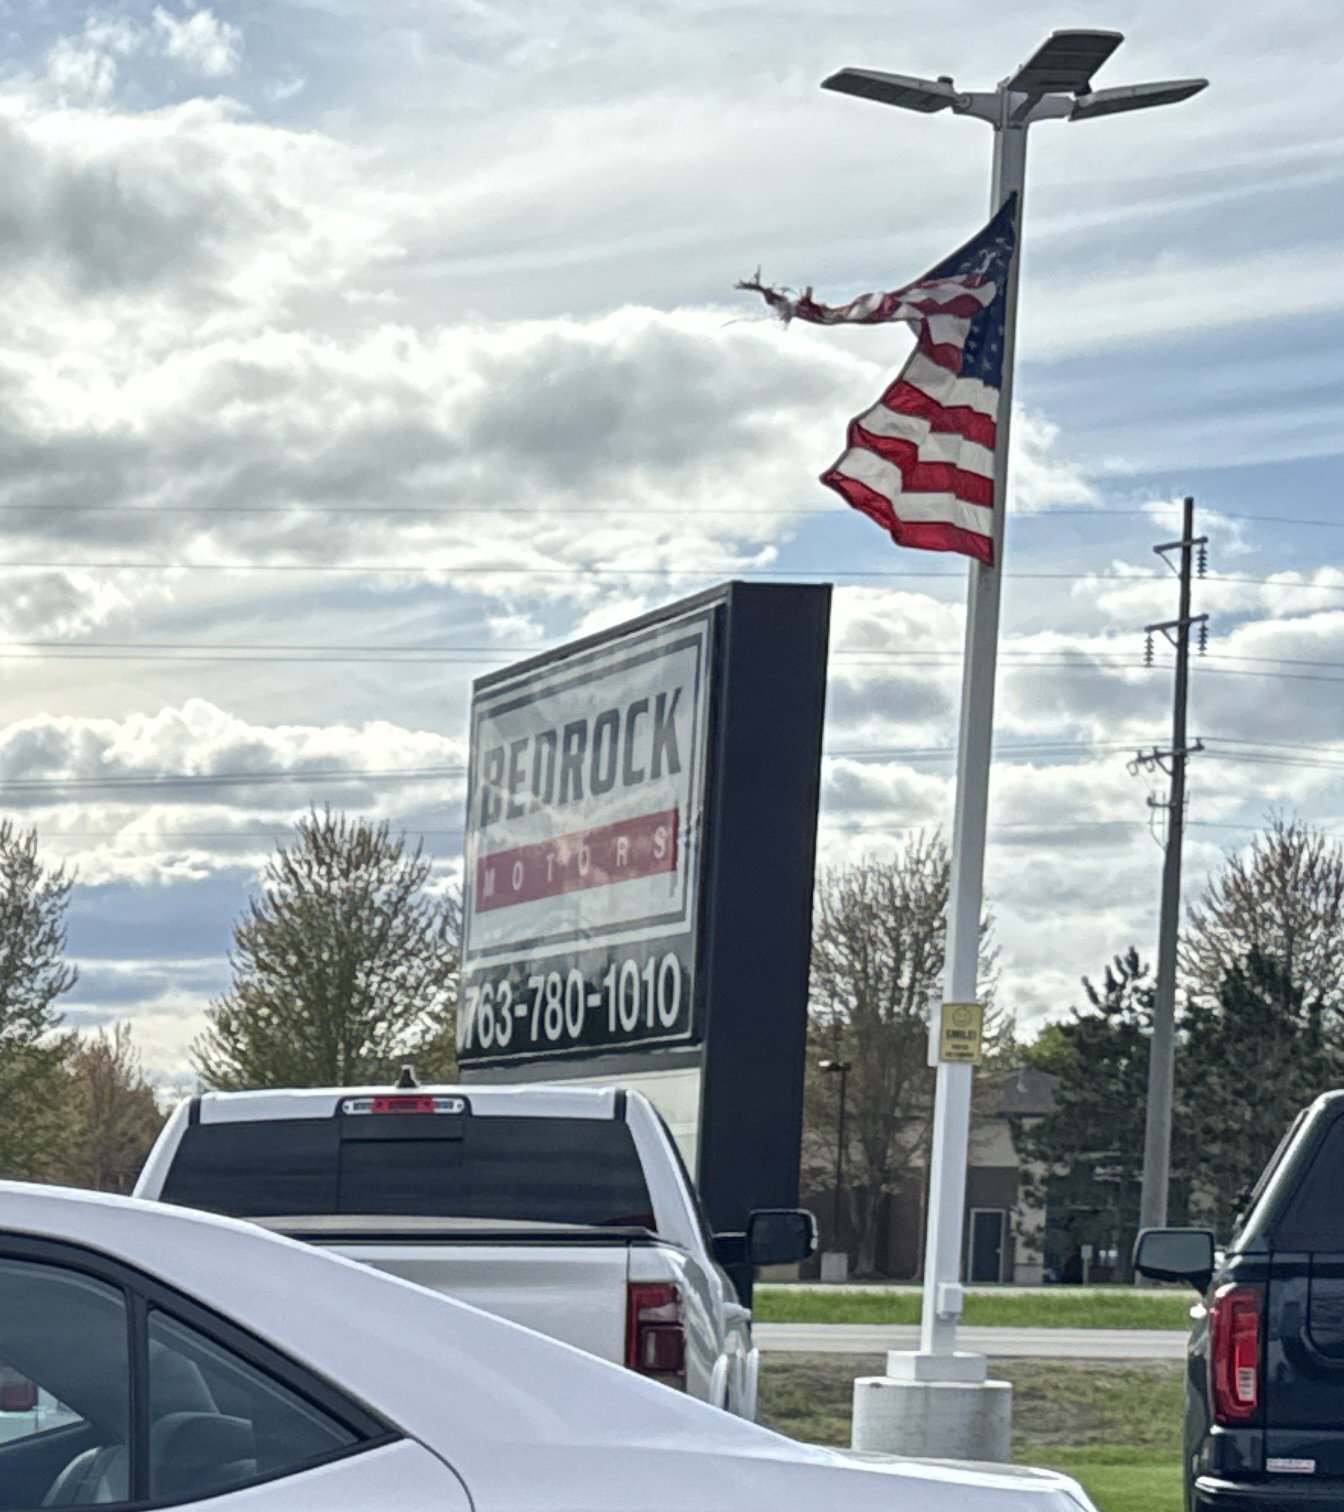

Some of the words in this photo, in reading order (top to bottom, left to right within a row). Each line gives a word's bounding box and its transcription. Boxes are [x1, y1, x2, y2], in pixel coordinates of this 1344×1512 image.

[480, 687, 683, 828] BEDROCK
[482, 826, 670, 897] MOTORS
[464, 952, 682, 1049] 763-780-1010
